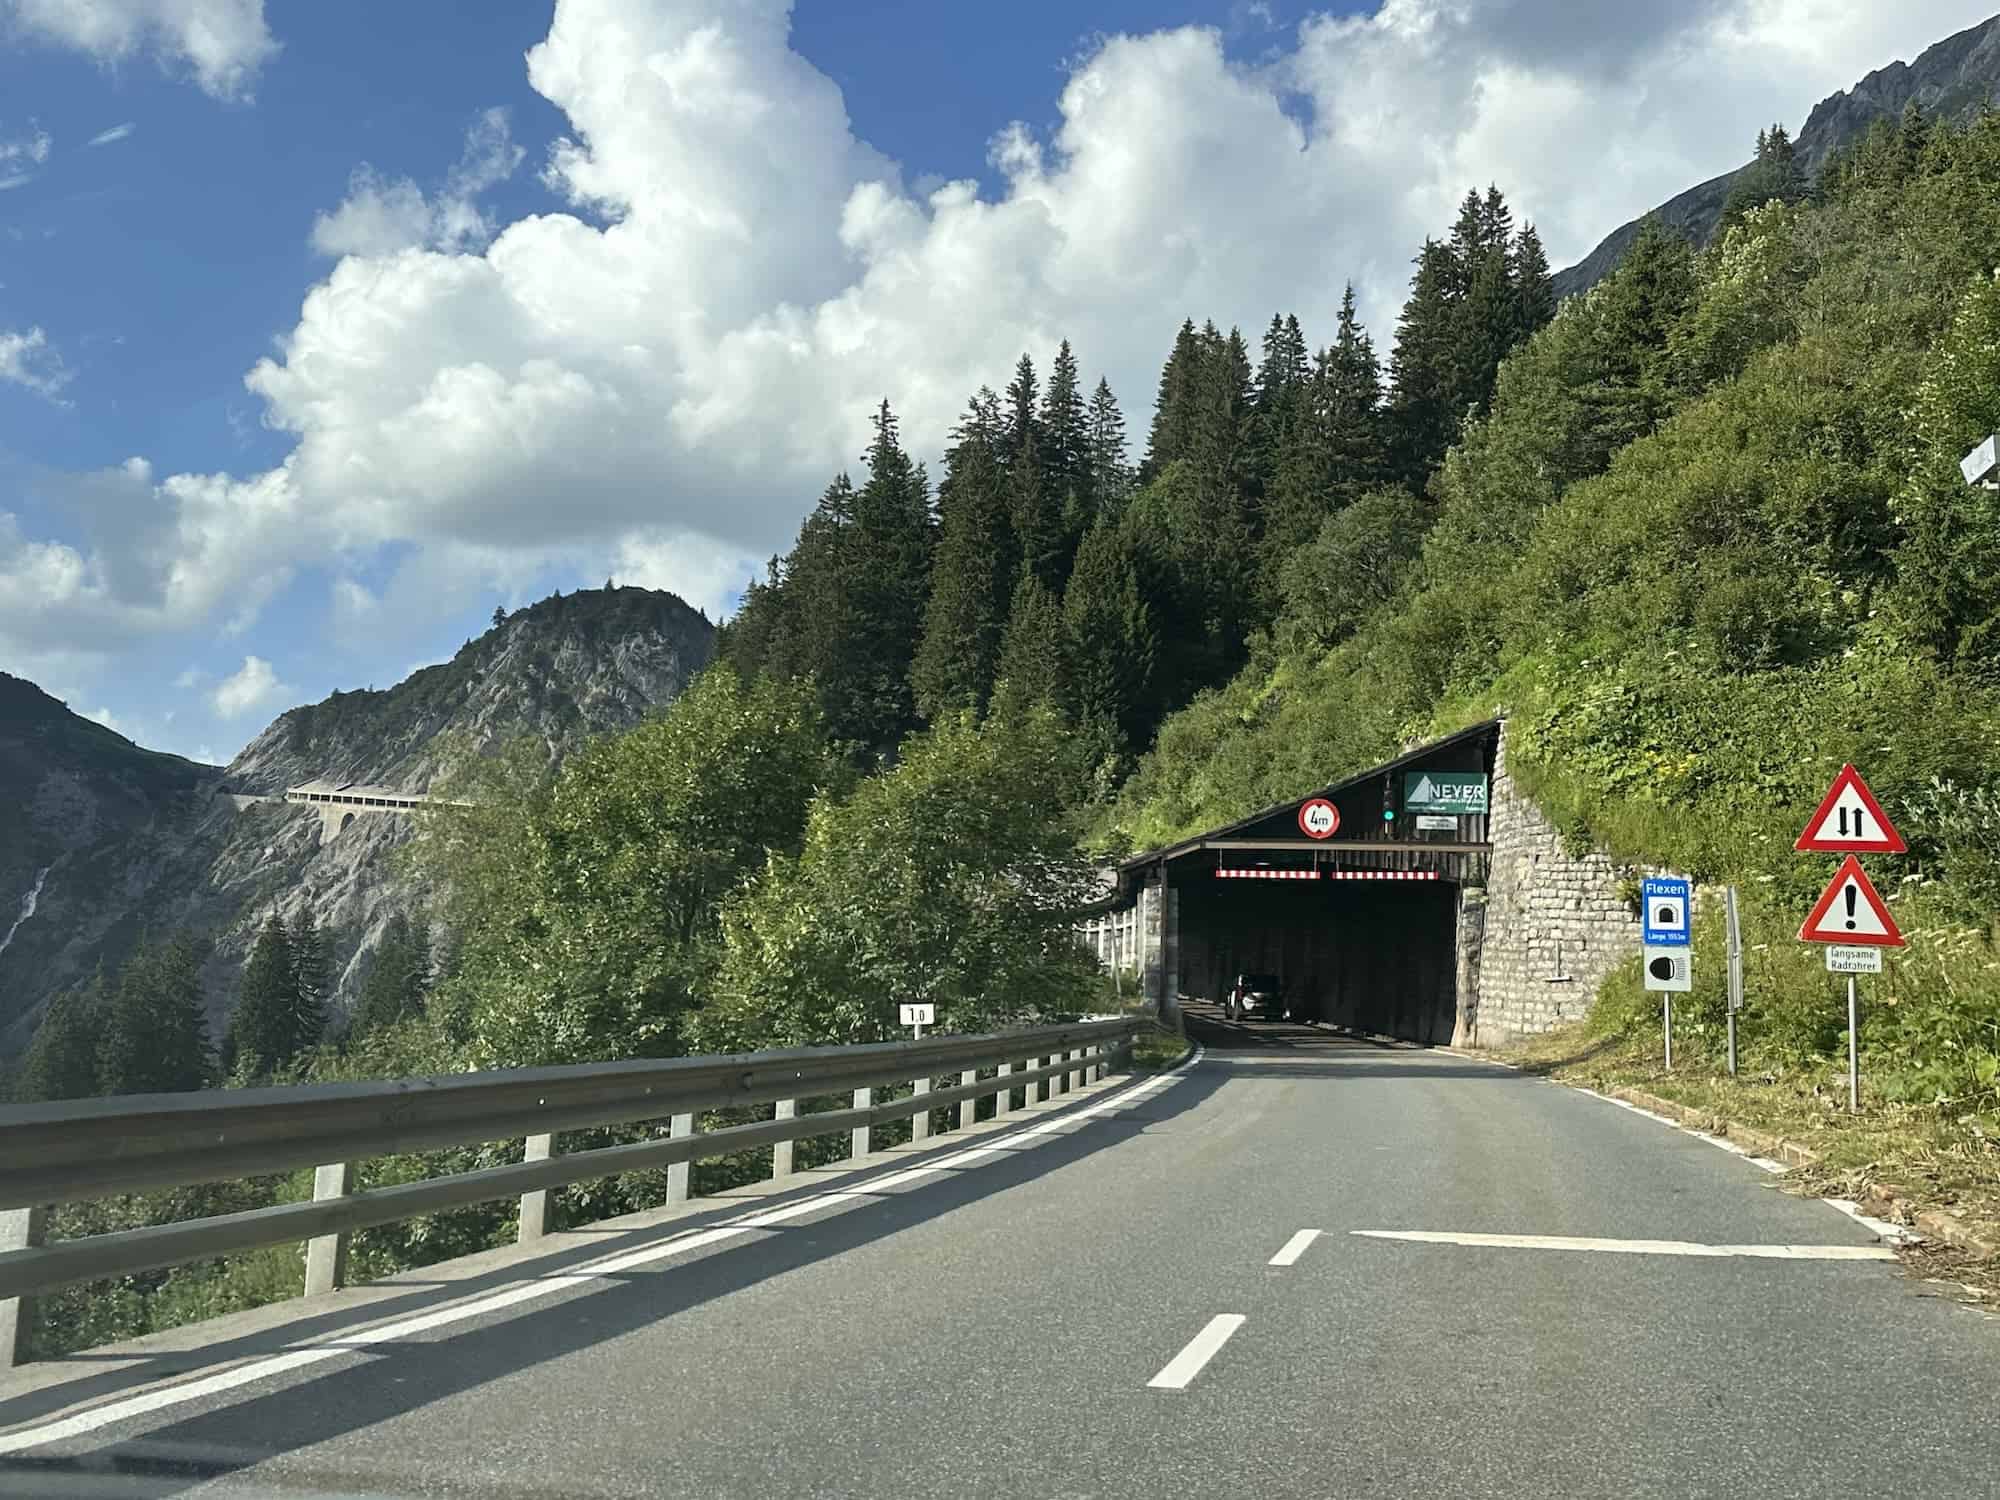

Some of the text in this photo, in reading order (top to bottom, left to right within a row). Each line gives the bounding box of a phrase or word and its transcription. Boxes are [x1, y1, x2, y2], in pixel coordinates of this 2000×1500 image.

[1430, 783, 1484, 799] NEYER
[1310, 810, 1329, 825] 4m
[1646, 883, 1685, 895] Flexen
[1831, 960, 1876, 970] Radfahrer
